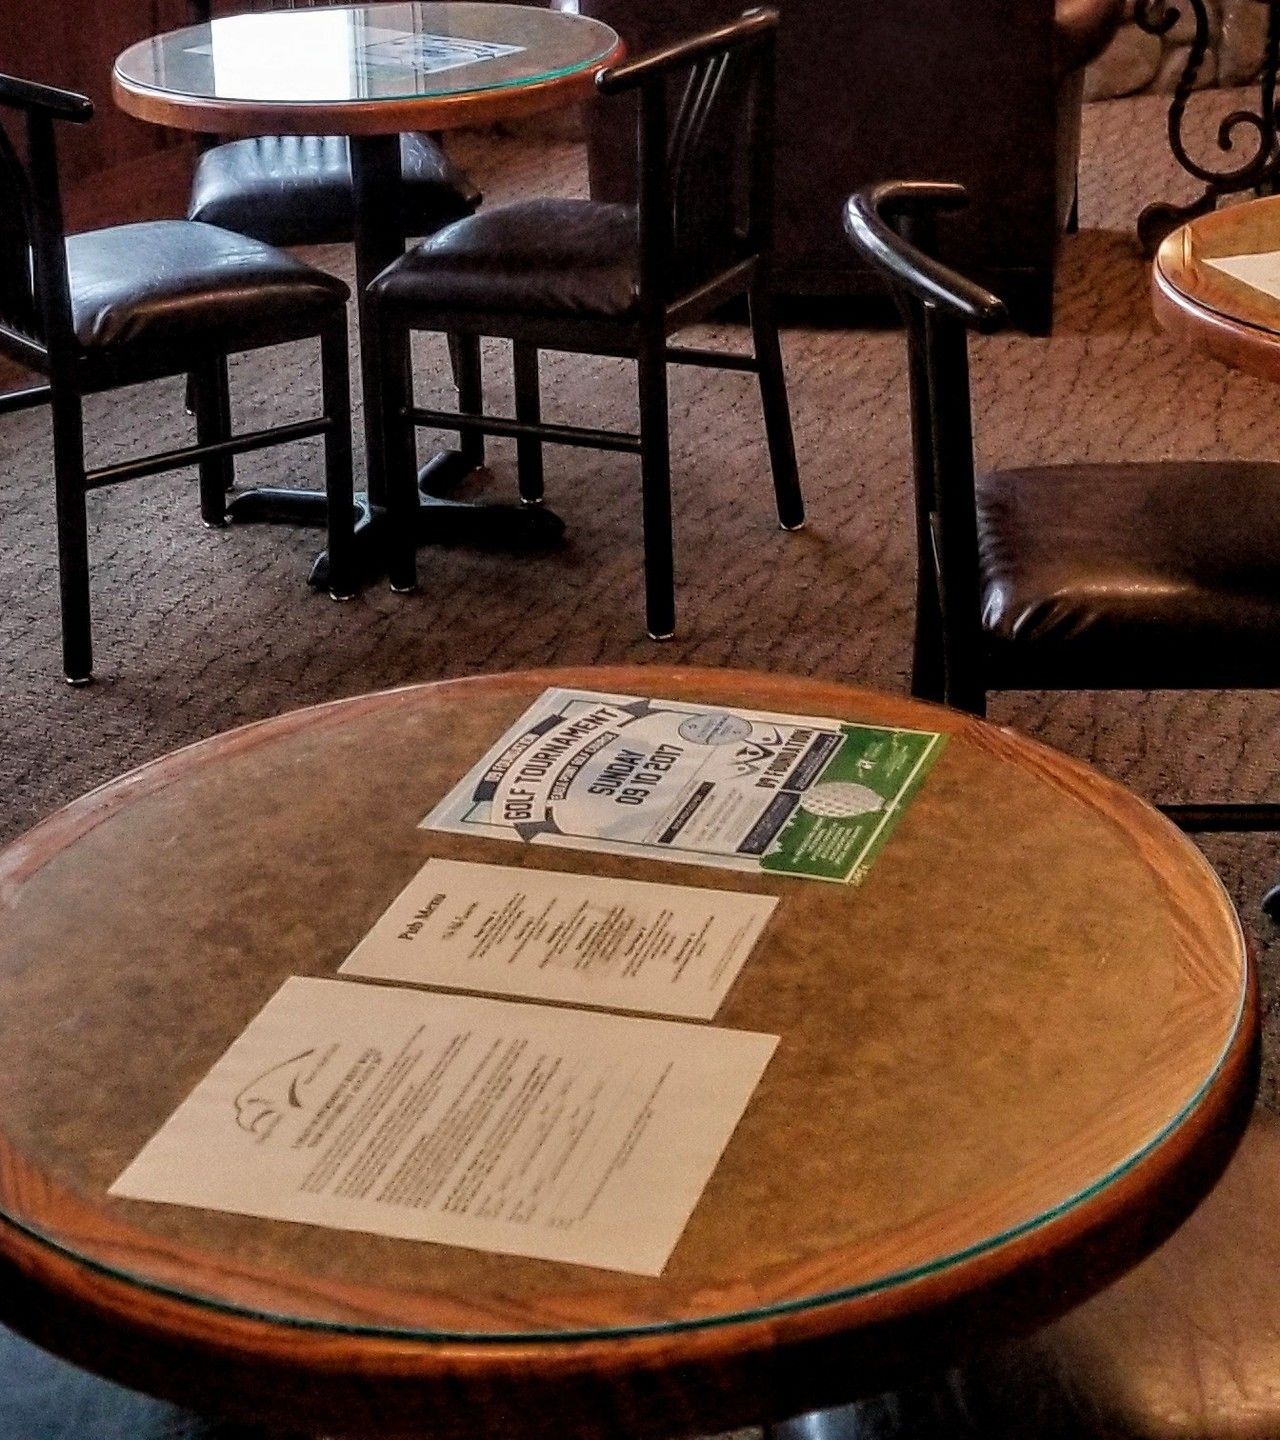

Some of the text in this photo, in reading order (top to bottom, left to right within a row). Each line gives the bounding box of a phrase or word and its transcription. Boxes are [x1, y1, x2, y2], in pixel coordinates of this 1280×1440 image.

[514, 707, 619, 783] TOURNAMENT
[648, 743, 685, 772] 2017
[587, 749, 646, 796] SUNDAY
[630, 773, 662, 786] 10
[503, 787, 537, 821] GOLF
[615, 786, 650, 806] 09
[398, 921, 424, 940] Pub
